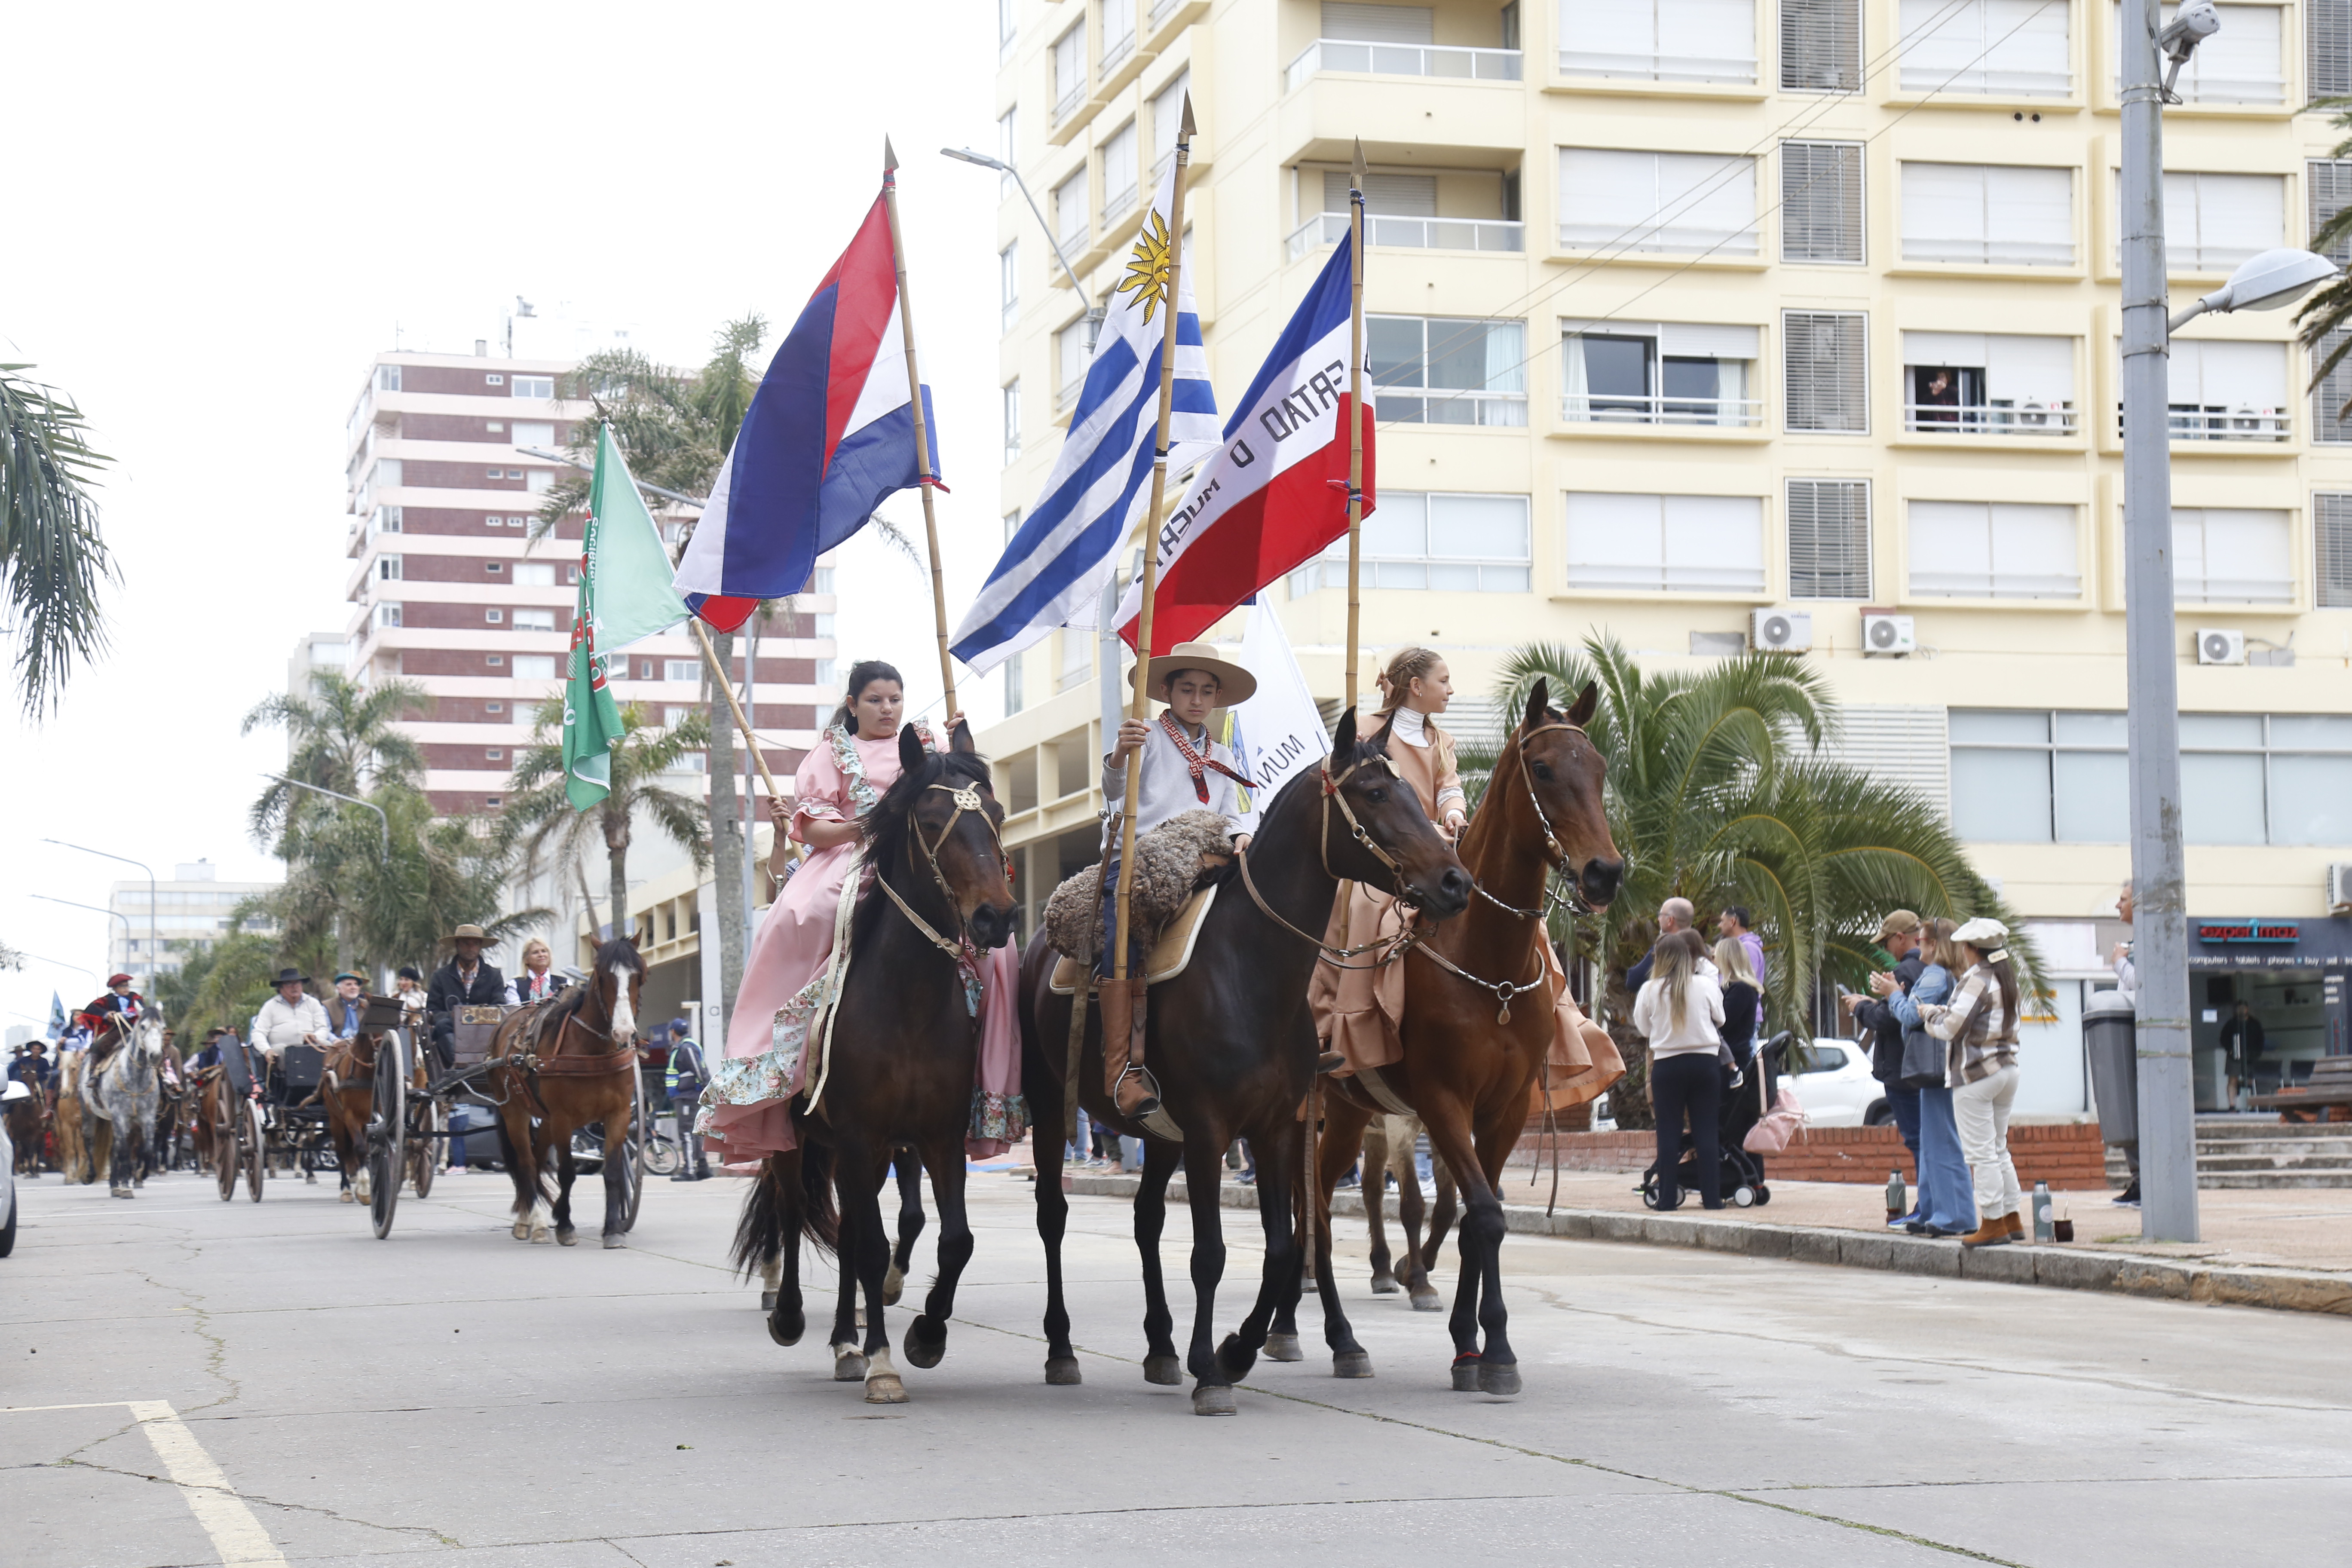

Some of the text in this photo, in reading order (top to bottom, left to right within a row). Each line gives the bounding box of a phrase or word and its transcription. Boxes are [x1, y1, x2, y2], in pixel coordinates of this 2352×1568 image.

[2236, 955, 2260, 965] tablets
[2268, 956, 2295, 966] phones
[2304, 956, 2319, 967] buy
